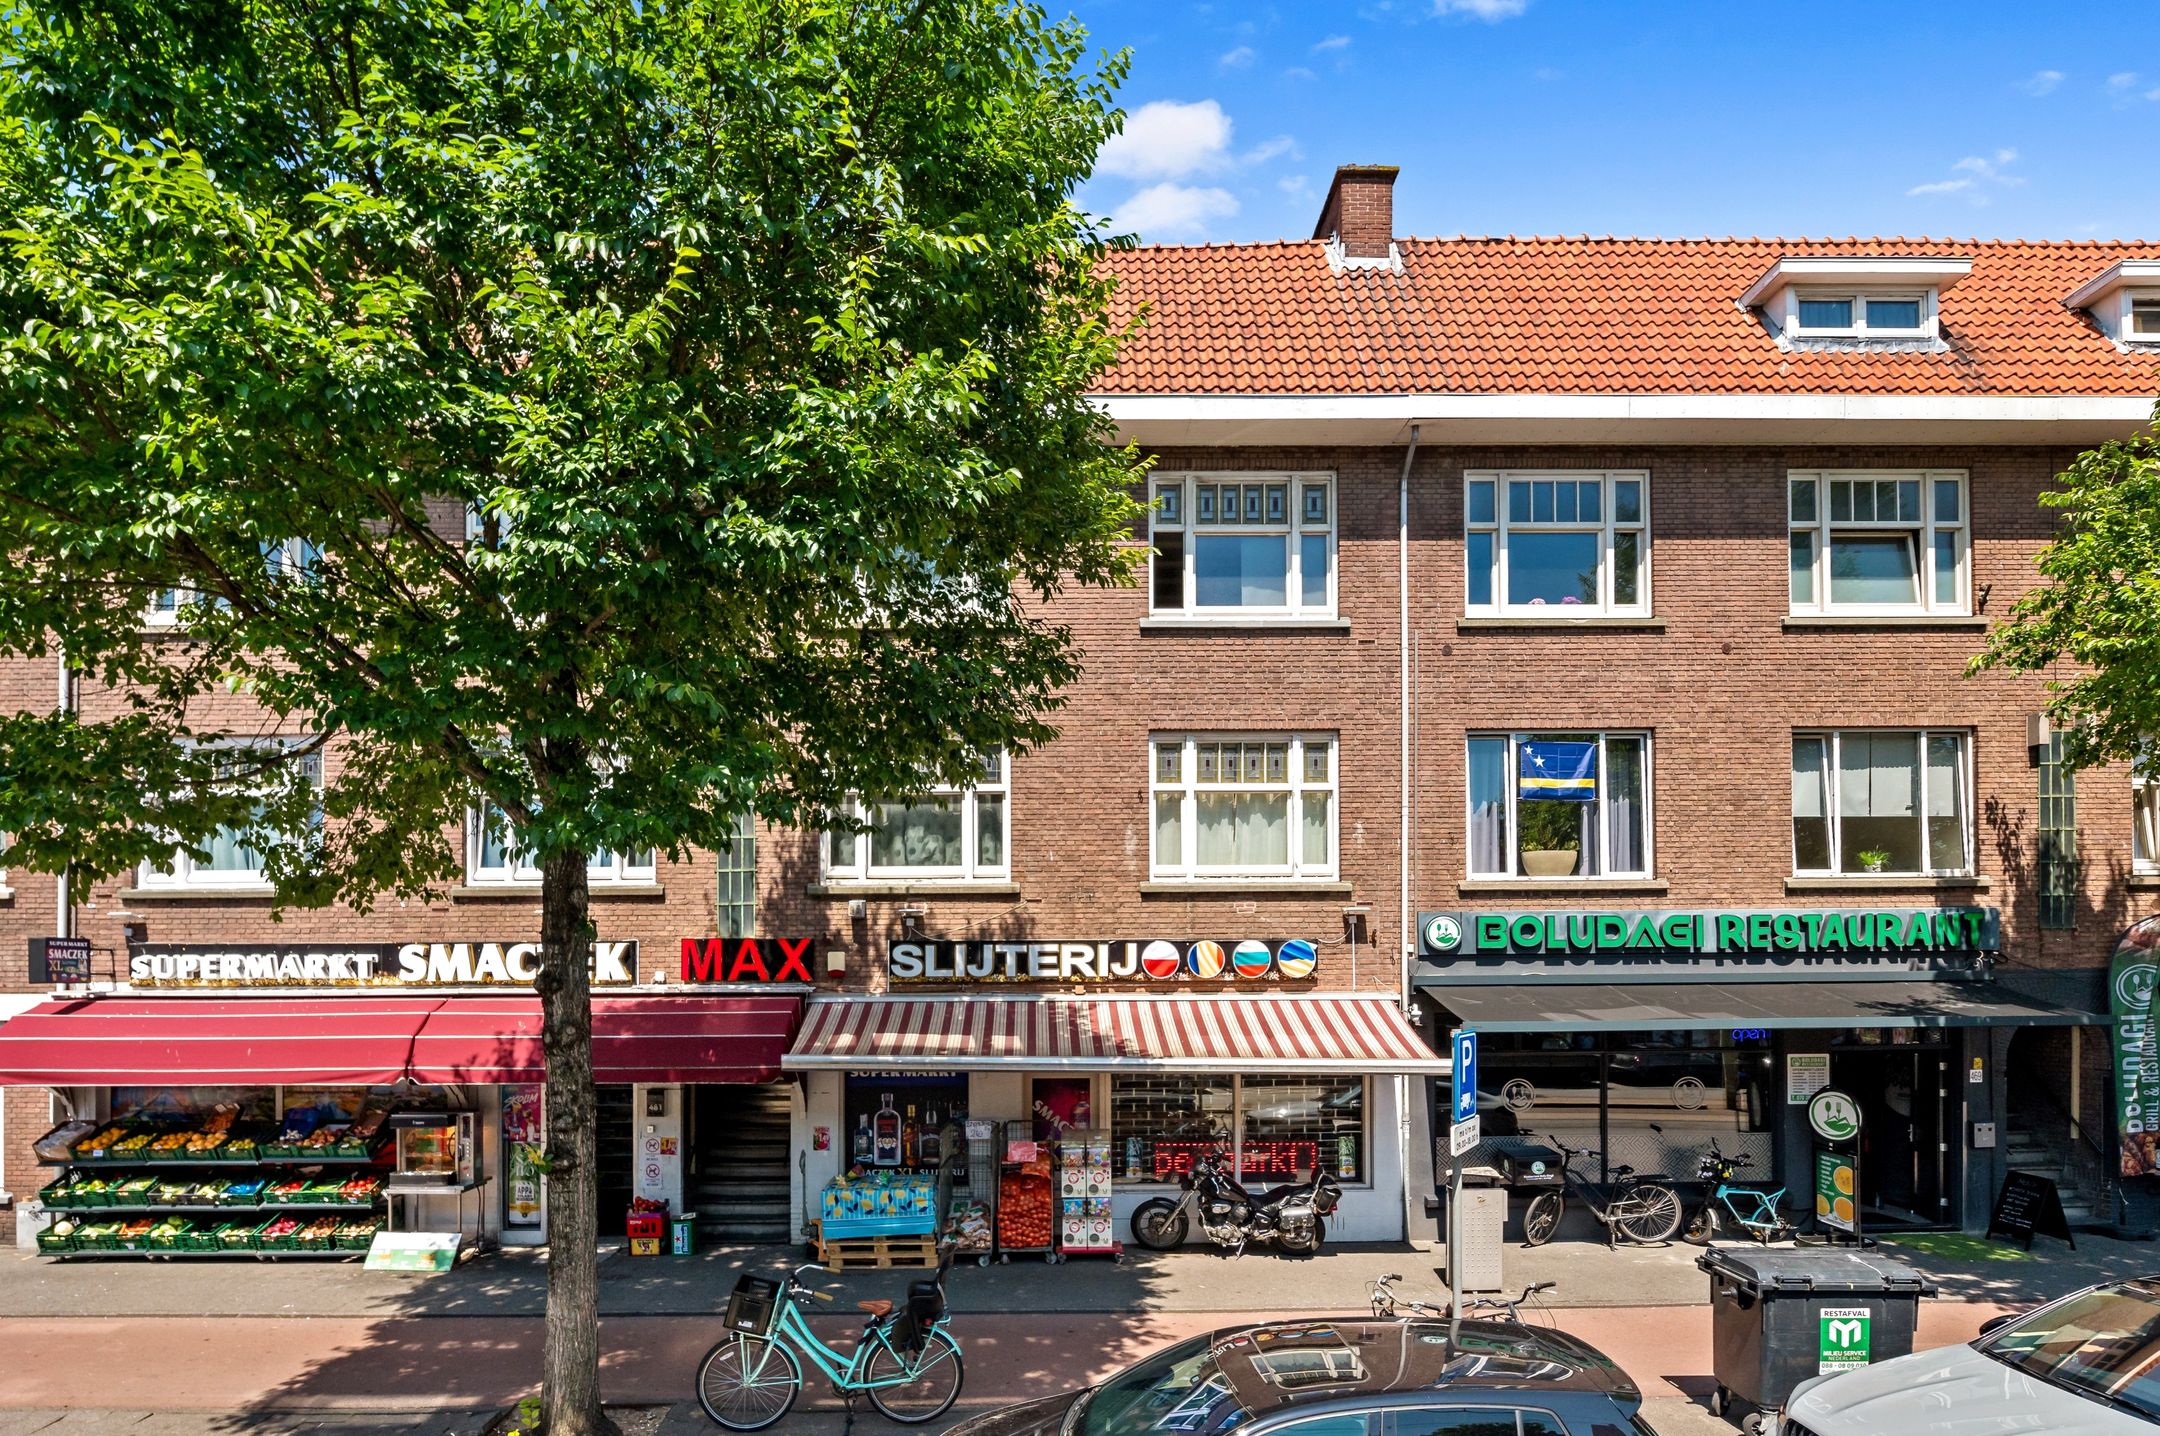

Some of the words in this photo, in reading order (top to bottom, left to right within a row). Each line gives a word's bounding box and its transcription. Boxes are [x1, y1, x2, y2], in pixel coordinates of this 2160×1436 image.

[1476, 915, 1703, 950] BOLUDAGI
[1719, 911, 1984, 950] RESTAURANT
[48, 948, 88, 959] SMACZEK
[49, 960, 63, 971] XL
[130, 953, 379, 980] SUPERMARKT
[398, 942, 633, 983] SMACK
[681, 938, 811, 982] MAX
[890, 942, 1139, 979] SLIJTERIJ
[1732, 1027, 1766, 1042] open
[1462, 1039, 1473, 1083] P
[2143, 1086, 2160, 1096] &
[2144, 1100, 2160, 1131] GRILL
